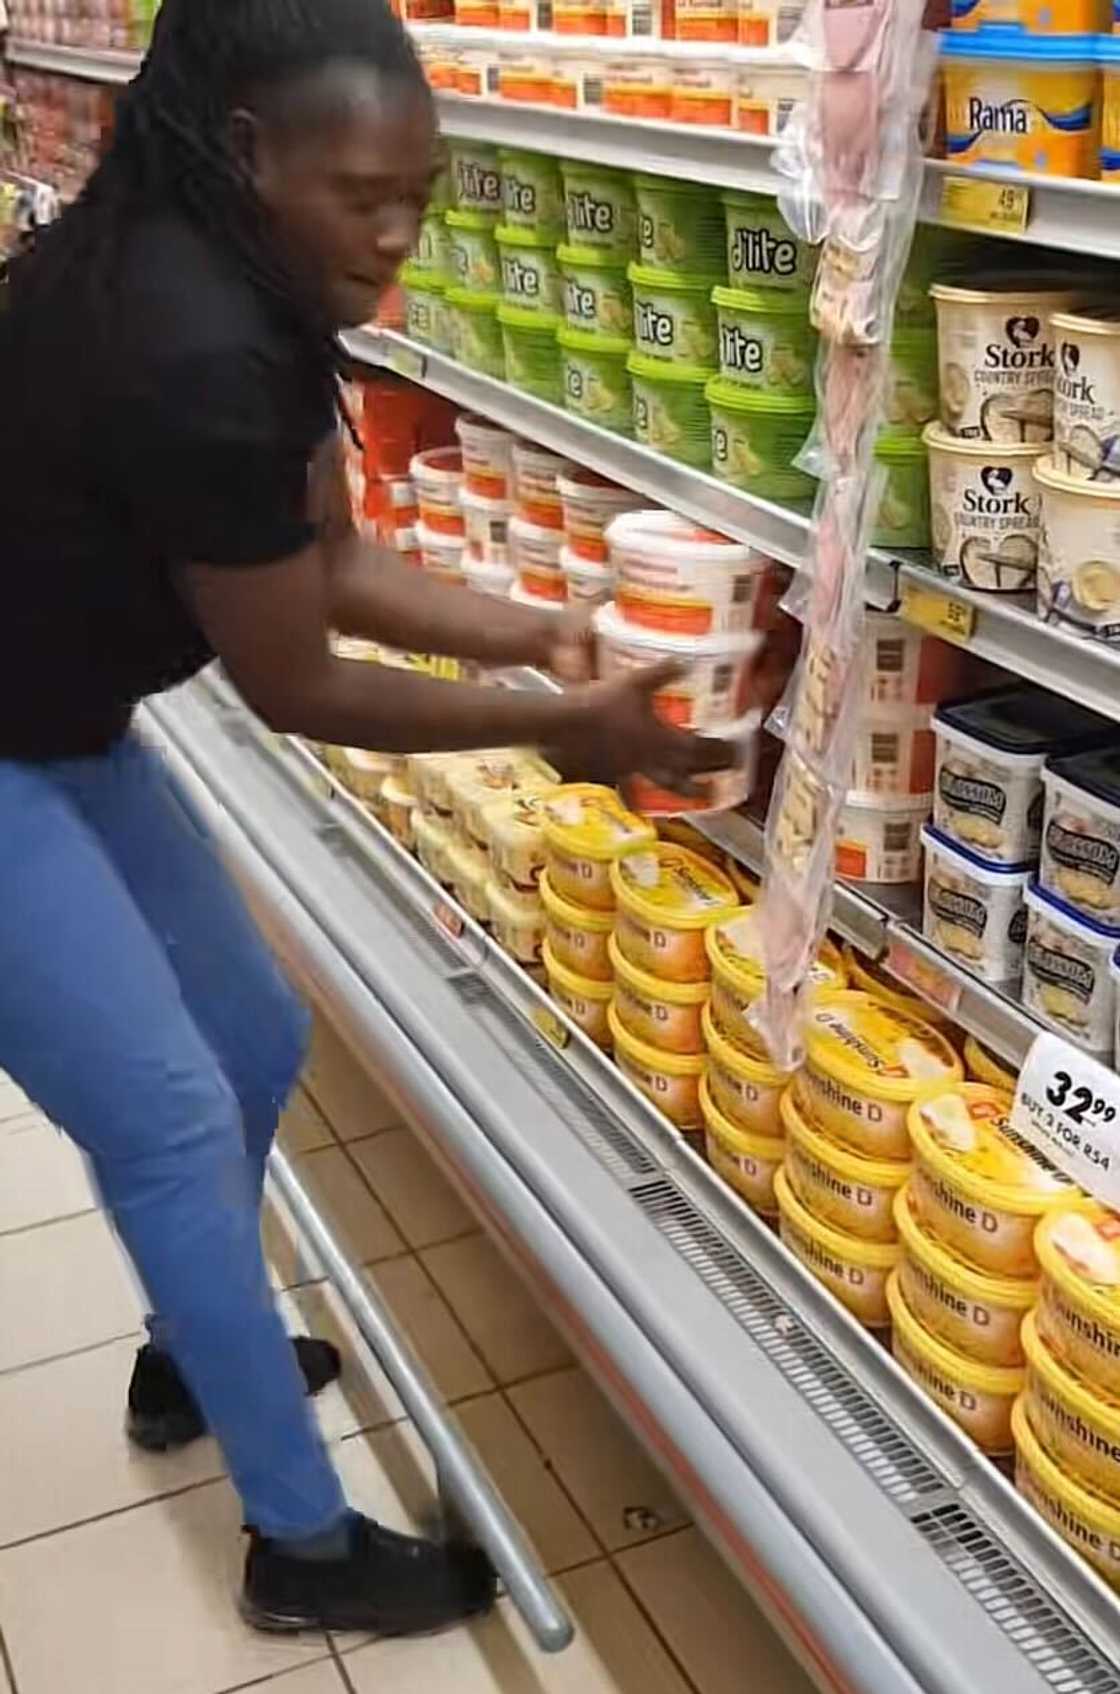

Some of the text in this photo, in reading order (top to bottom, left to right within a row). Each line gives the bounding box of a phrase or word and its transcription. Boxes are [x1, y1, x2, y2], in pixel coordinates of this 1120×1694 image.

[969, 96, 1028, 135] Rama
[731, 228, 797, 275] d'lite
[984, 343, 1055, 369] Stork
[963, 488, 1031, 516] Stork
[867, 1104, 882, 1122] D
[1056, 1121, 1081, 1151] FOR
[1083, 1143, 1110, 1171] R54
[857, 1187, 872, 1206] D
[981, 1211, 998, 1233] D
[849, 1266, 864, 1285] D
[973, 1305, 990, 1326] D
[960, 1391, 976, 1410] D
